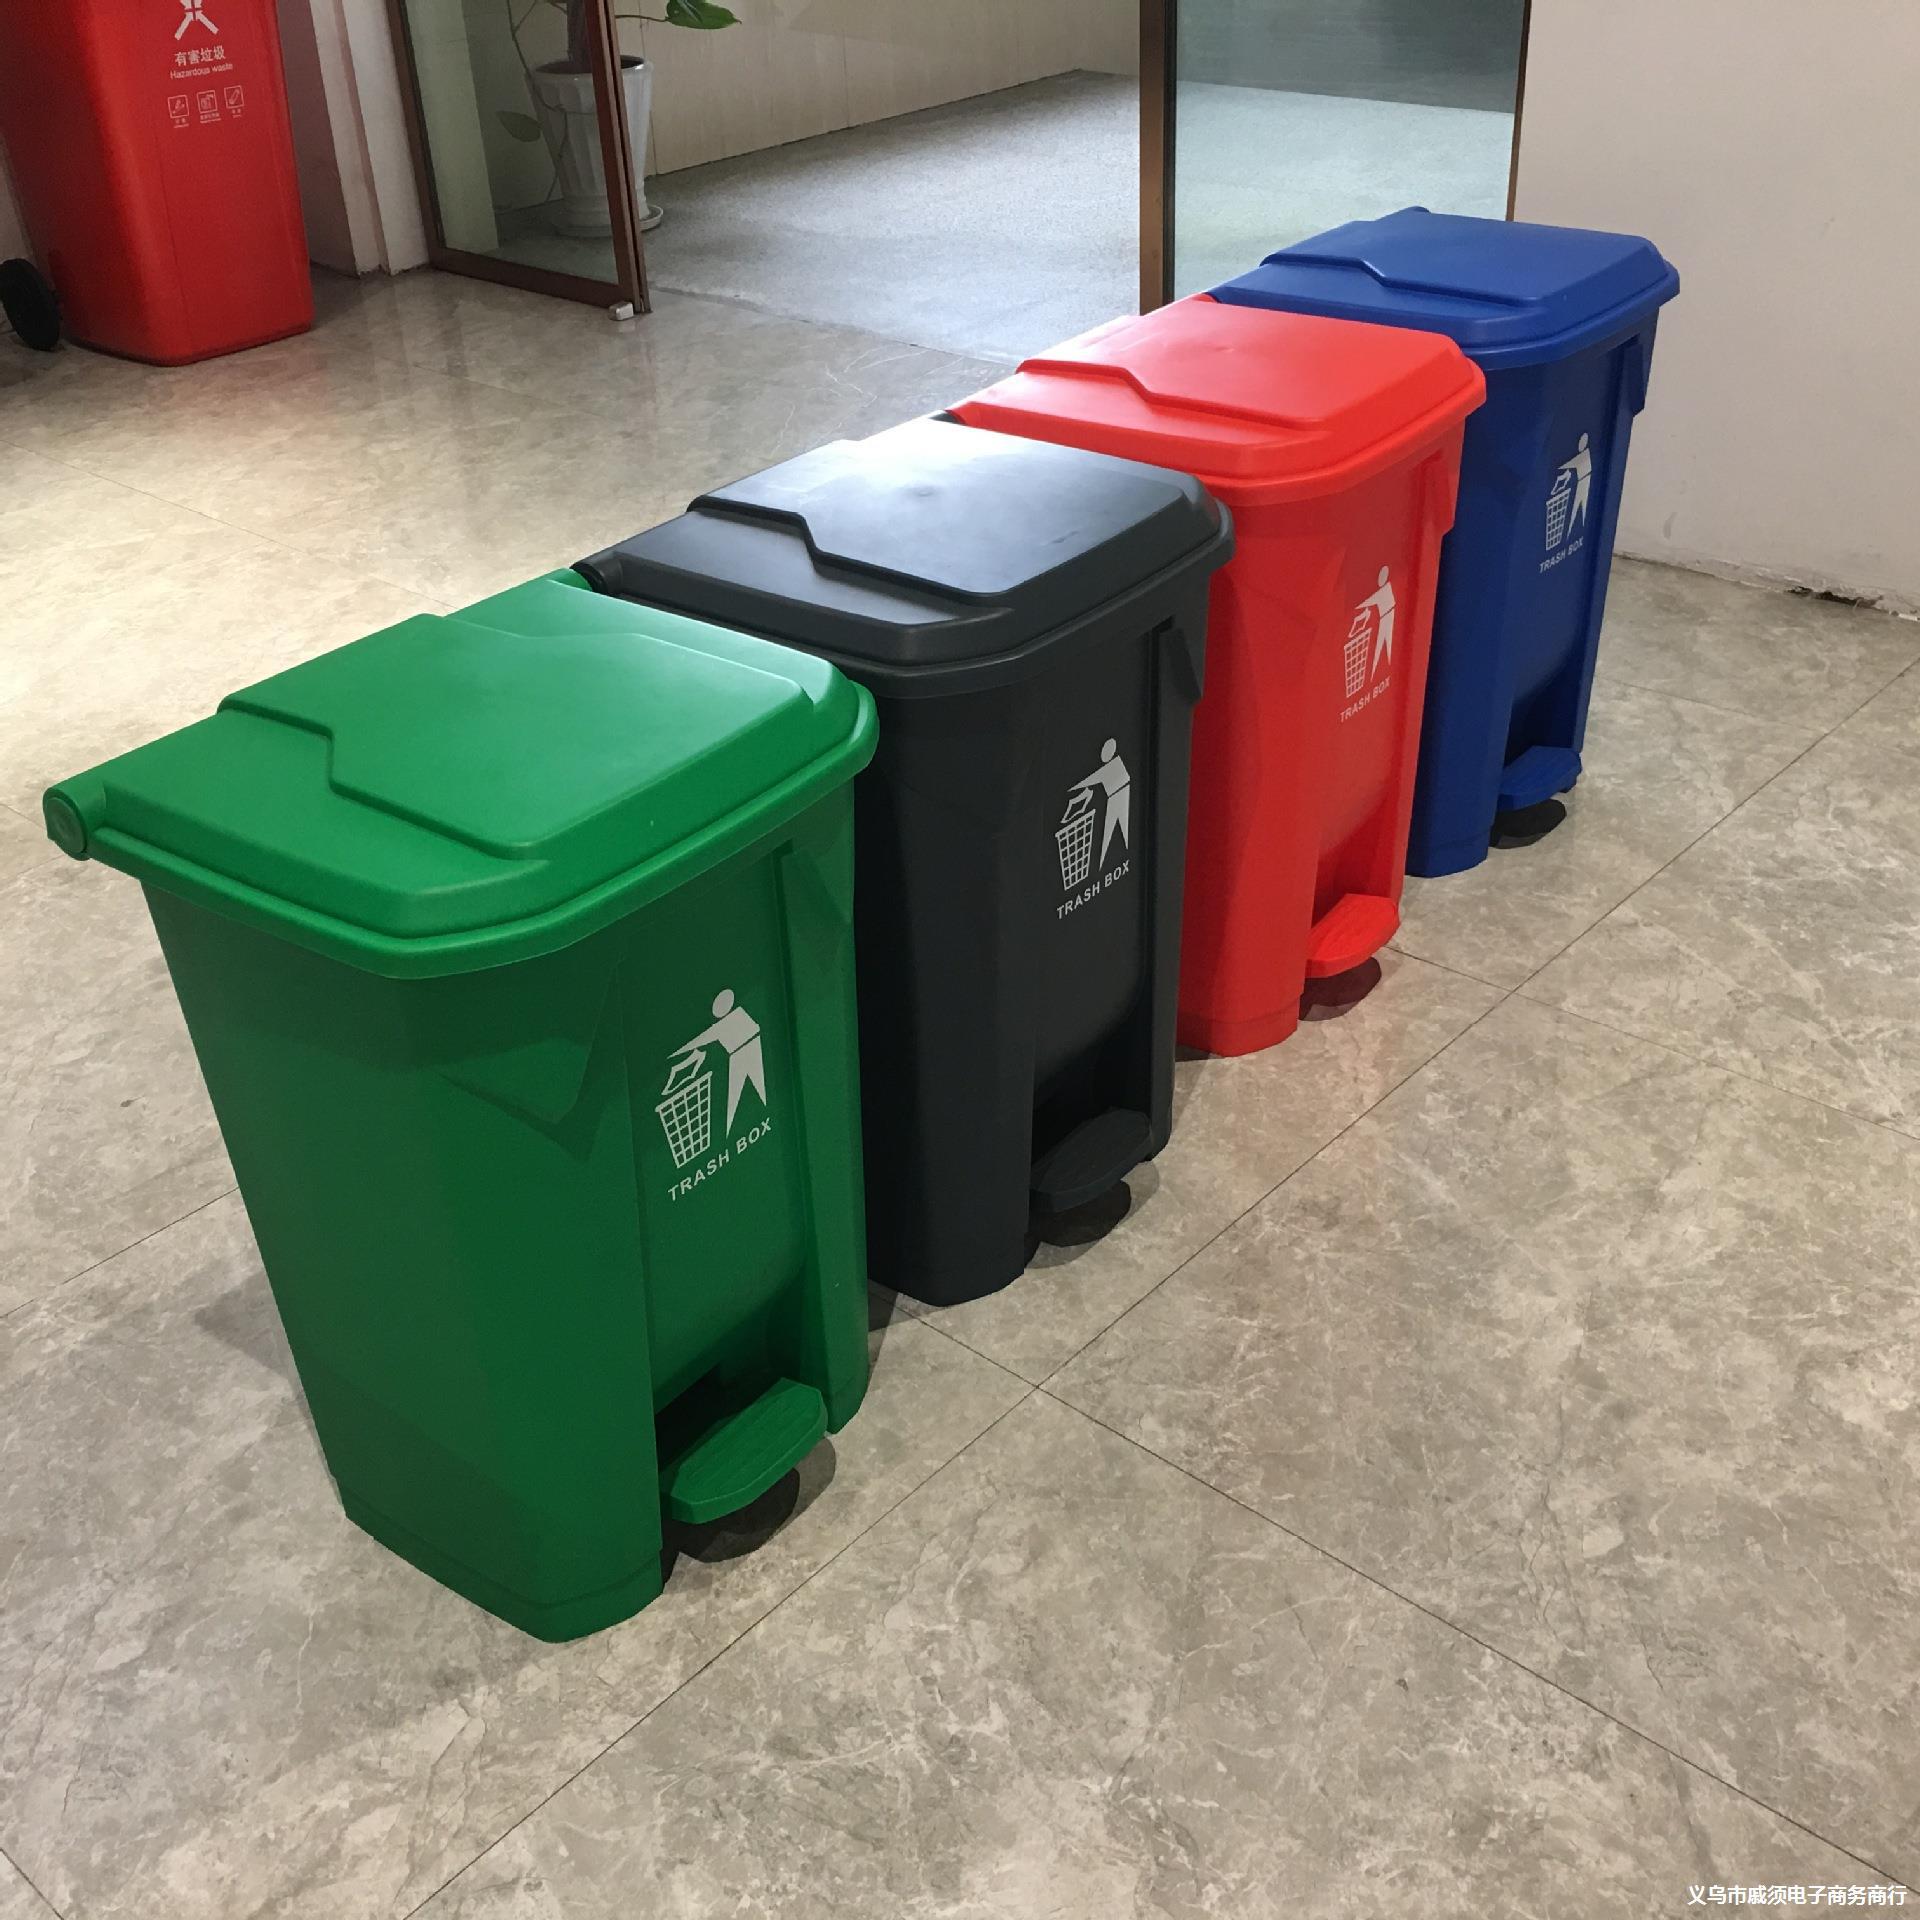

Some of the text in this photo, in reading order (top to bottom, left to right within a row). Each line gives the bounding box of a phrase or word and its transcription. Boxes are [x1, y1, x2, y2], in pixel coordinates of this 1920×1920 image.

[170, 63, 233, 79] Hazardous waste
[174, 45, 226, 67] 有害垃圾
[1539, 536, 1584, 573] TRASH BOX
[1340, 676, 1391, 723] TRASH BOX
[1056, 859, 1130, 920] TRASH BOX
[667, 1117, 772, 1202] TRASH BOX
